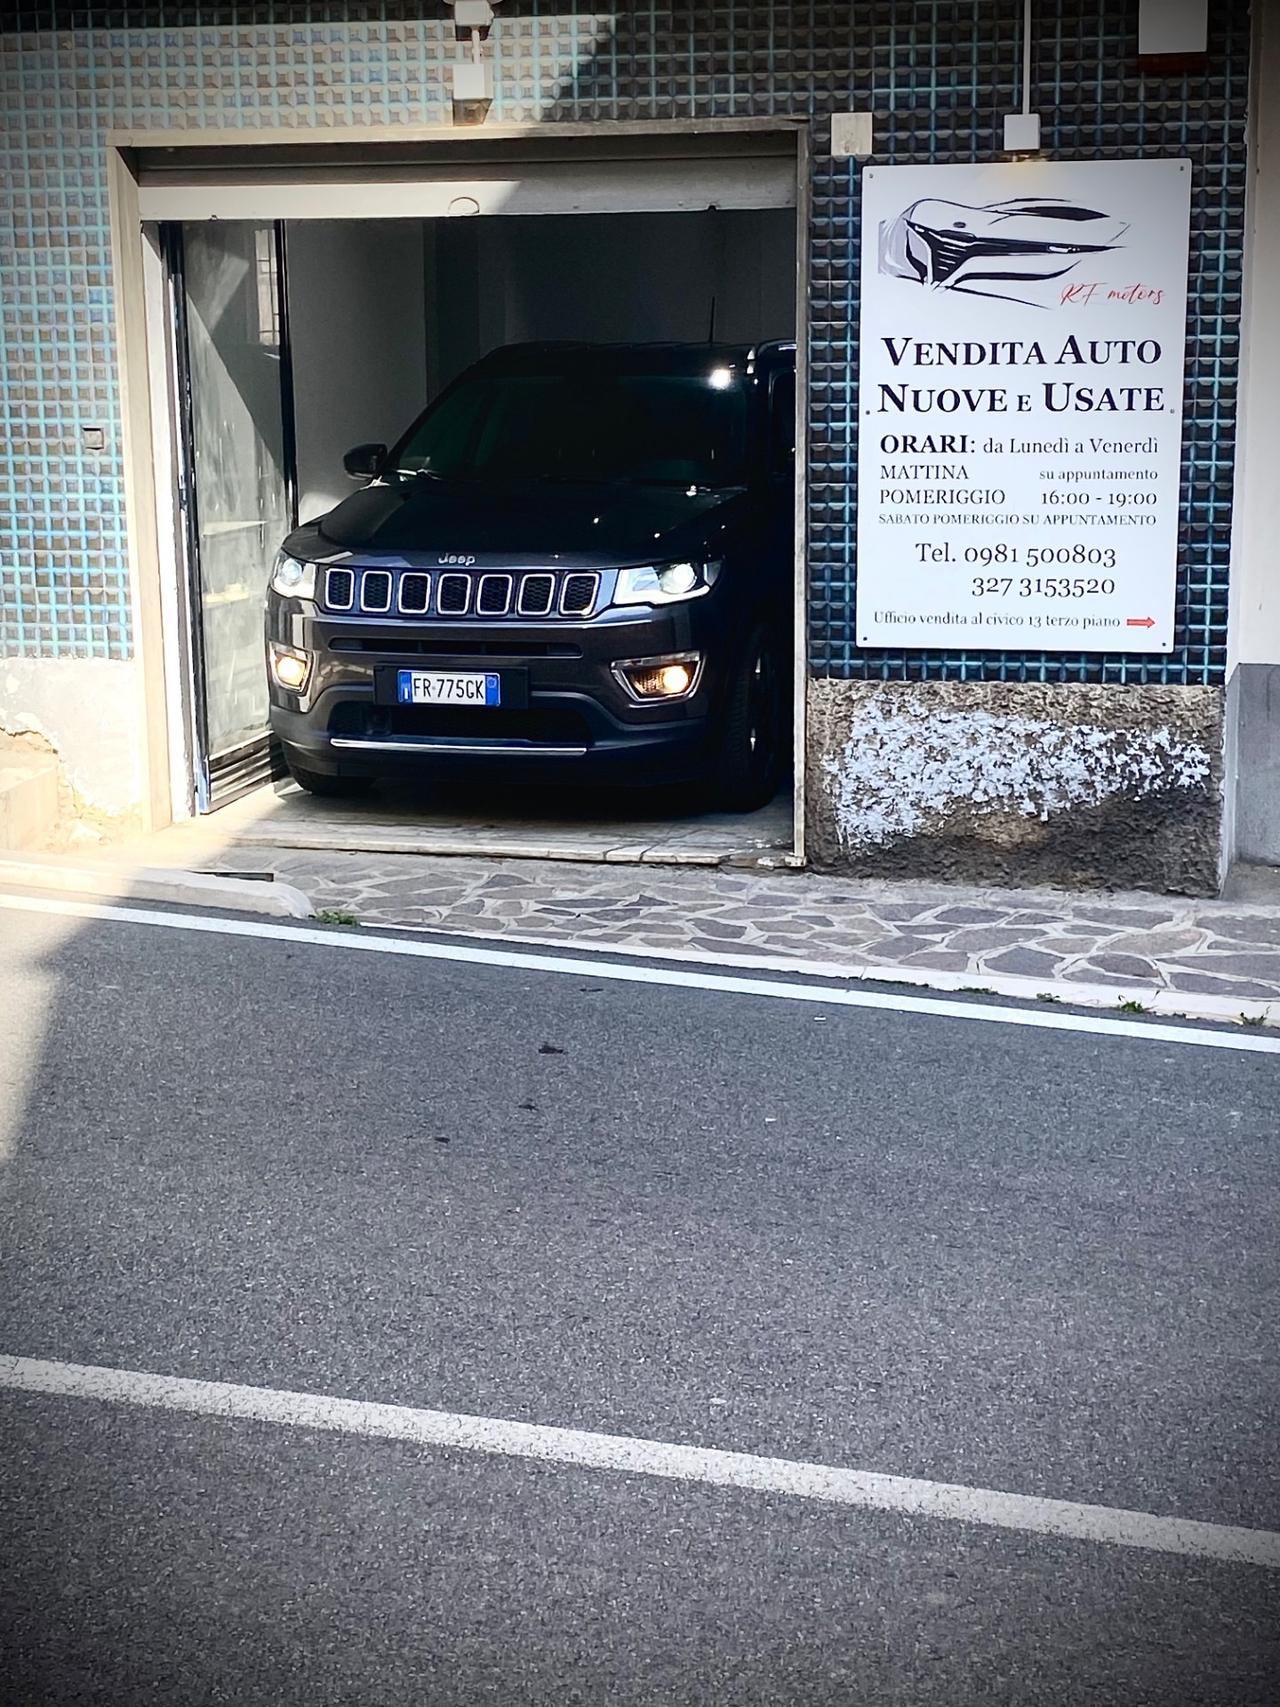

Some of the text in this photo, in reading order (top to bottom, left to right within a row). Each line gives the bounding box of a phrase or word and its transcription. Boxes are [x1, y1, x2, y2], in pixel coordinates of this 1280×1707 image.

[1108, 283, 1164, 305] motors
[881, 335, 1162, 366] VENDITA AUTO
[877, 384, 1008, 413] NUOVE
[1043, 382, 1164, 412] USATE
[880, 435, 1158, 454] ORARI: da Lunedì a Venerdì
[880, 465, 970, 480] MATTINA
[1039, 469, 1158, 482] su appuntamento
[880, 489, 1005, 504] POMERIGGIO
[1041, 492, 1090, 505] 16:00
[1109, 493, 1157, 506] 19:00
[878, 514, 1156, 526] SABATO POMERIGGIO SU APPUNTAMENTO
[438, 553, 475, 566] Jeep
[916, 543, 1116, 568] Tel. 0981 500803
[971, 578, 1115, 597] 327 3153520
[874, 612, 1120, 629] Ufficio vendita al civico 13 terzo piano
